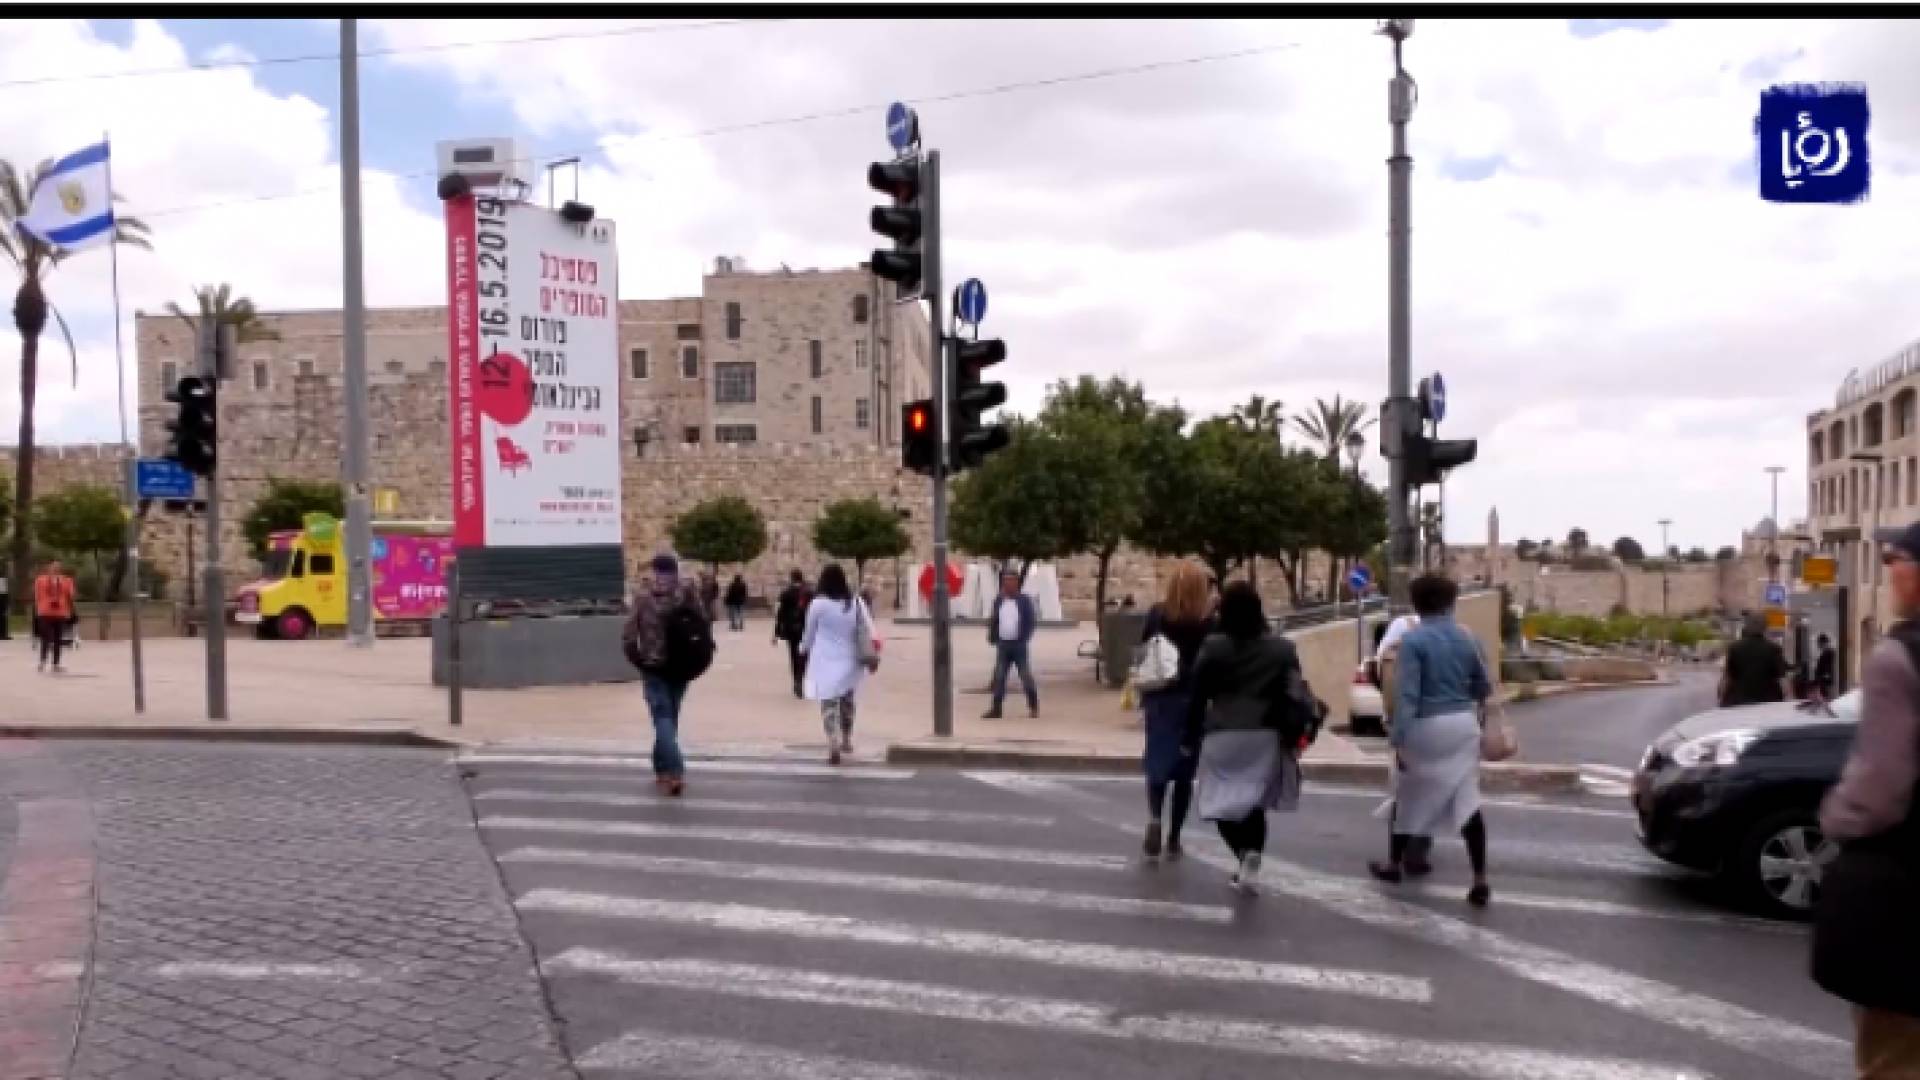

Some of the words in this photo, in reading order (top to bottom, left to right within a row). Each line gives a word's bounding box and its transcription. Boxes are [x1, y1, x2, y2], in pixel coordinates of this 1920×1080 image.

[539, 251, 597, 284] פסטיבל
[539, 286, 607, 318] הסופרים
[520, 316, 567, 344] פורום
